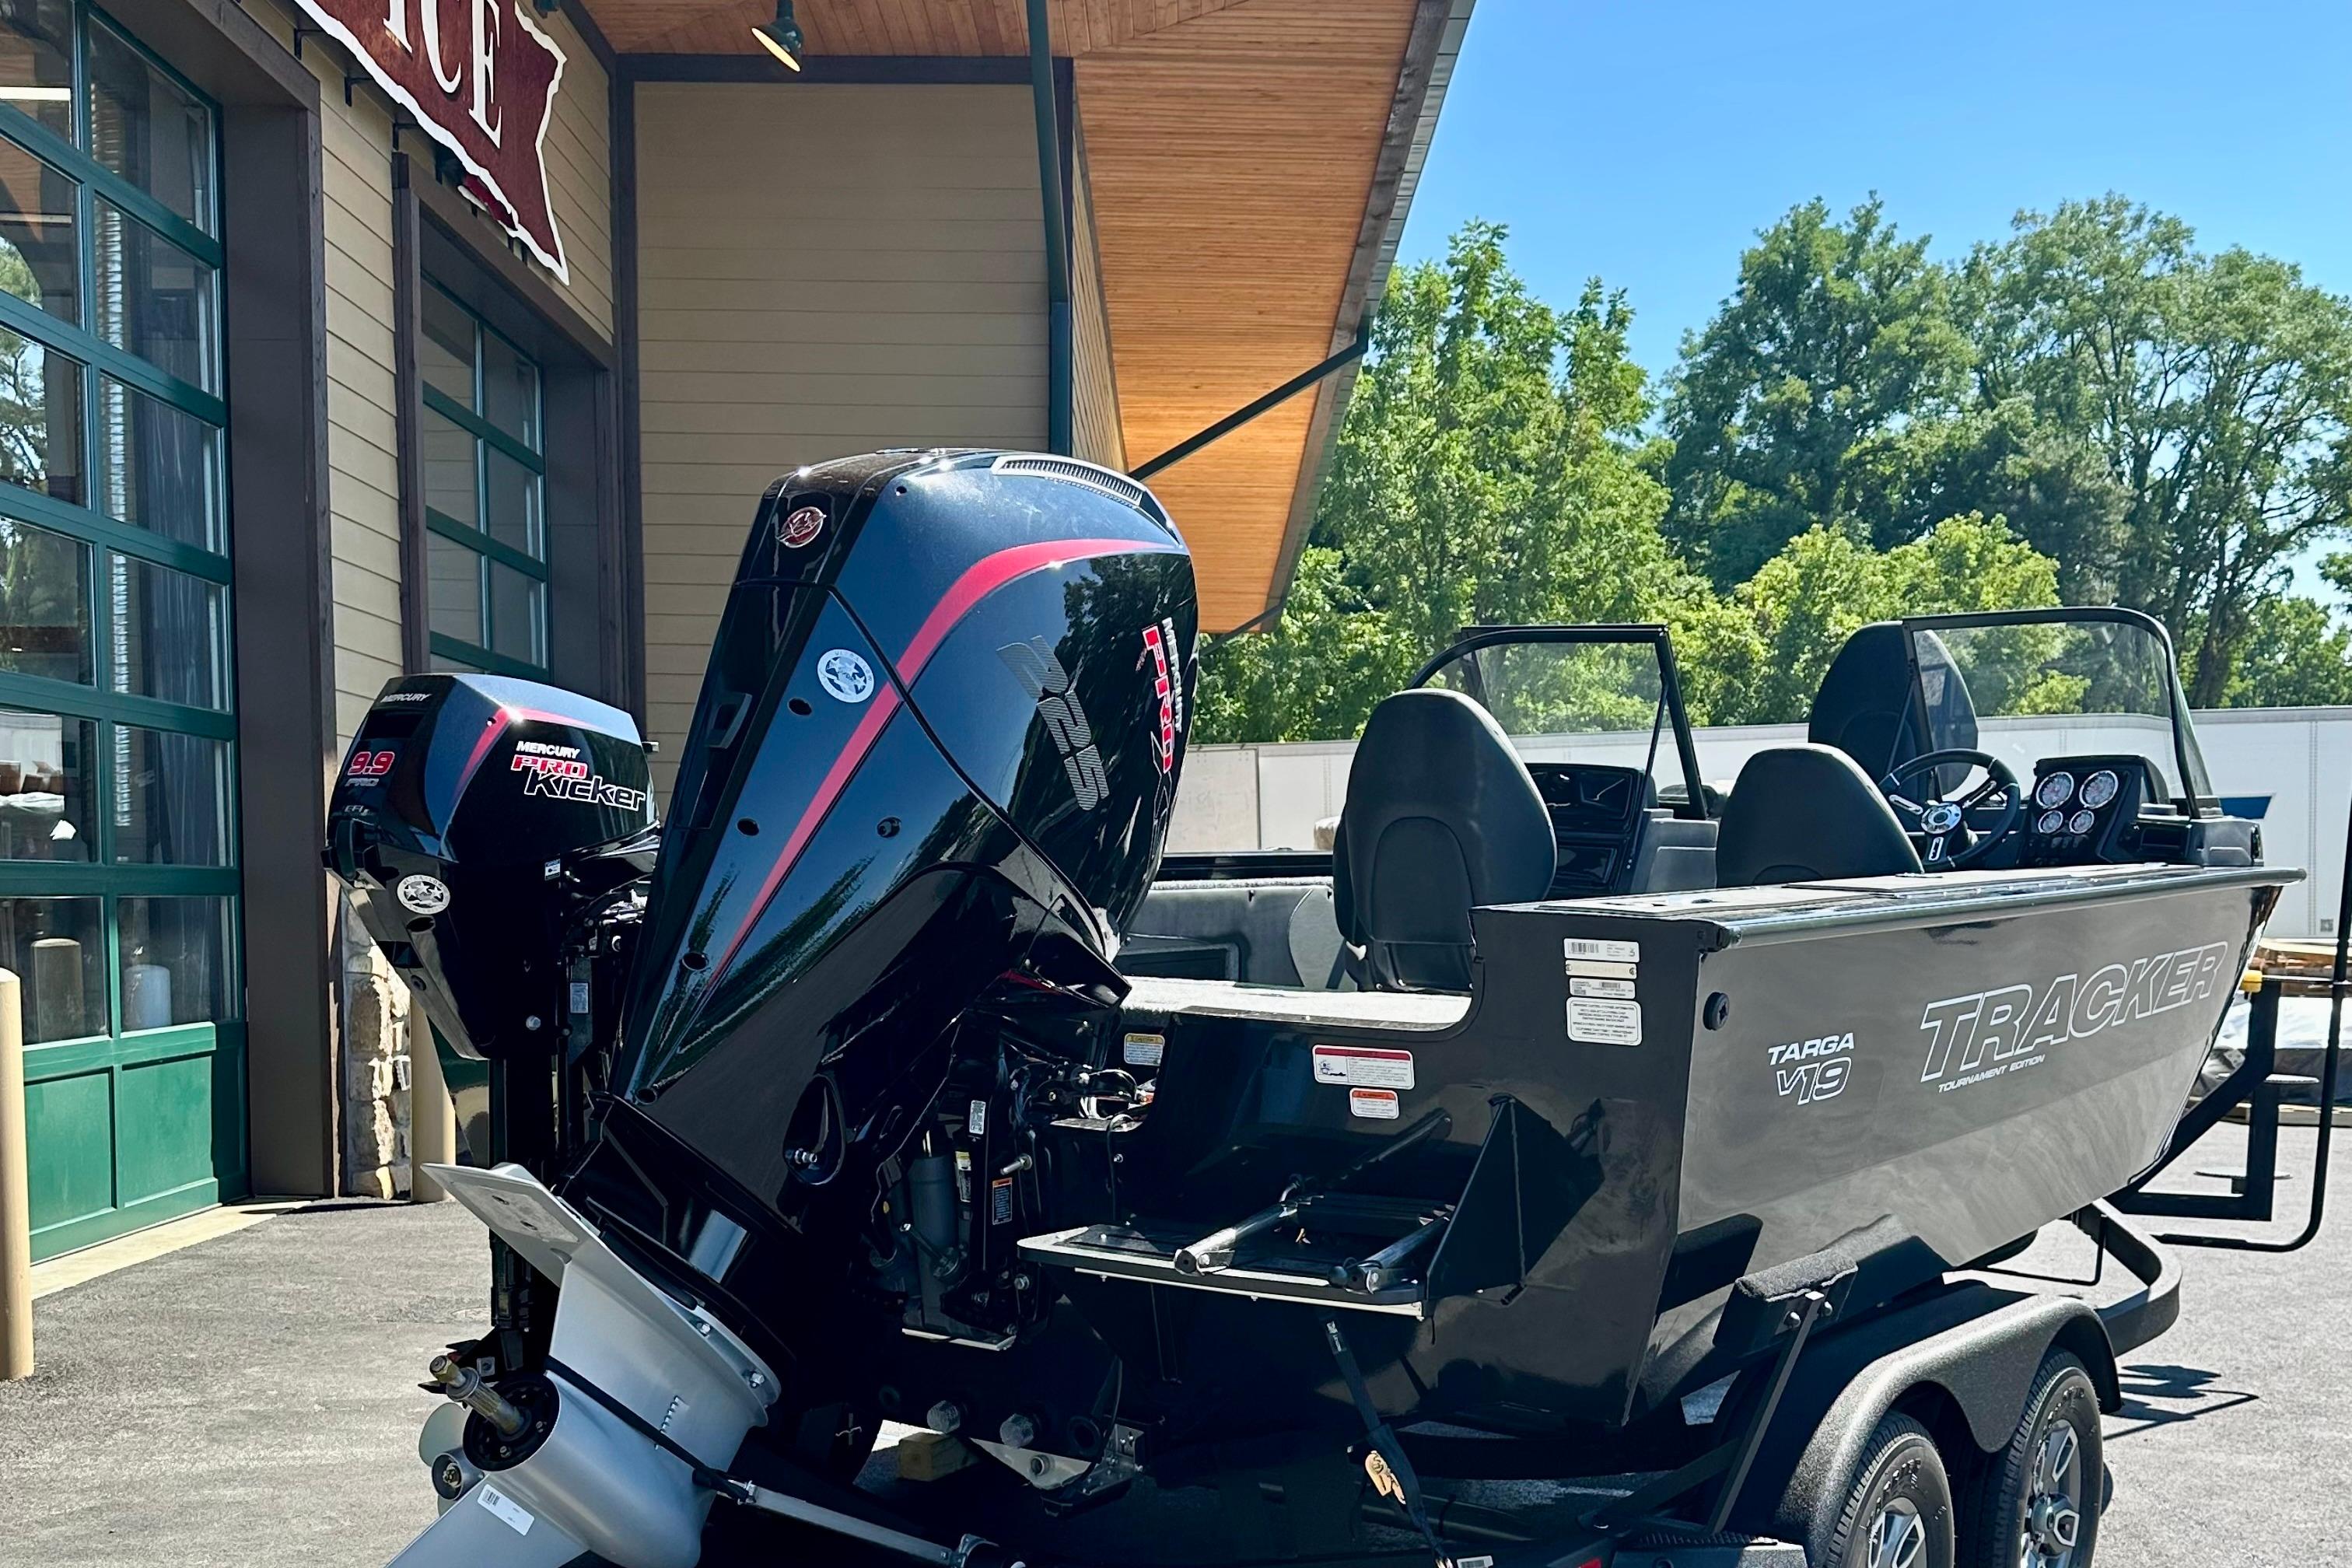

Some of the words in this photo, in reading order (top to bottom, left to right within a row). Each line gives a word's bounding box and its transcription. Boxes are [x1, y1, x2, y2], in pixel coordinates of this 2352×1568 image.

[380, 693, 431, 702] MERCURY
[1143, 625, 1173, 775] PRO
[996, 635, 1109, 811] 225
[347, 751, 396, 776] 9.9
[510, 754, 588, 779] PRO
[516, 740, 581, 759] MERCURY
[345, 778, 379, 787] PRO
[1920, 940, 2228, 1083] TRACKER
[1768, 1032, 1854, 1066] TARGA
[1776, 1056, 1852, 1105] V19
[1938, 1065, 2007, 1094] TOURNAMENT
[2009, 1054, 2046, 1072] EDITION
